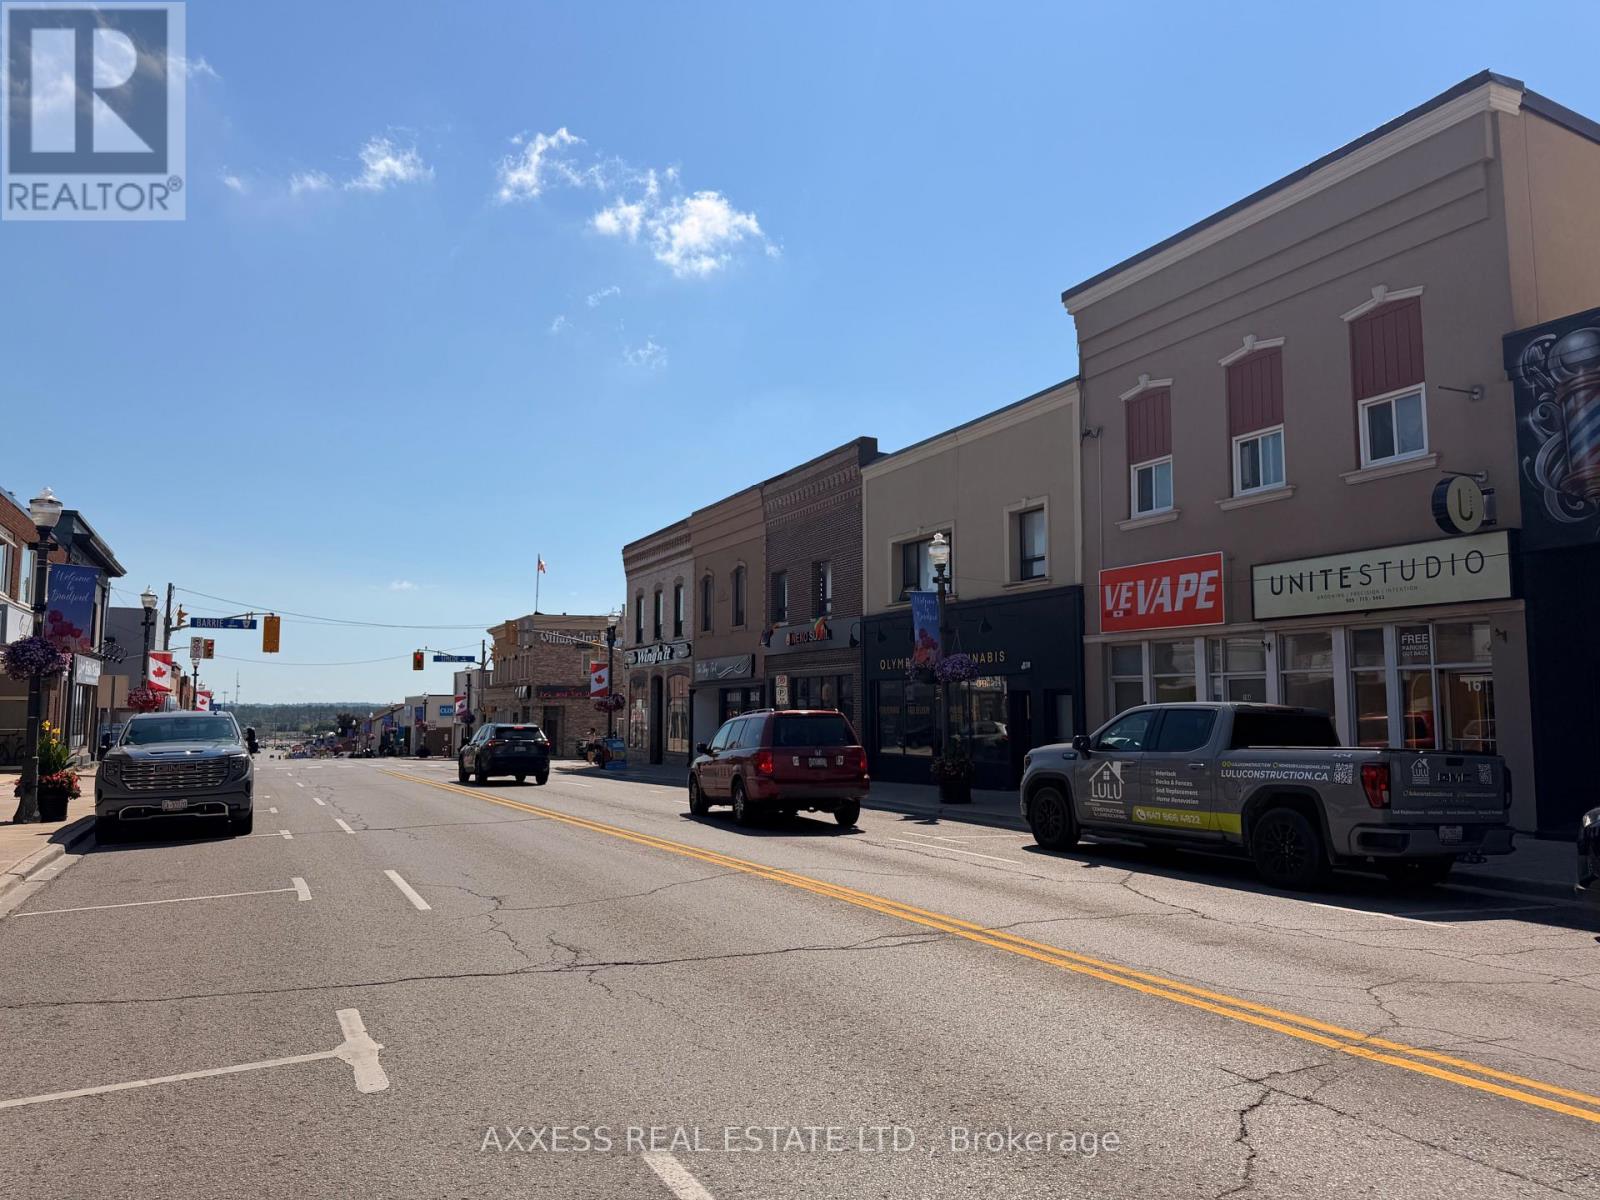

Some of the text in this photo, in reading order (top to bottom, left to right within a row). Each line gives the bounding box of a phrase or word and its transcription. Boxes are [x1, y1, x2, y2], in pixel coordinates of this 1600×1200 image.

[55, 569, 90, 584] Welcome
[49, 588, 90, 605] Bradford
[196, 618, 225, 628] BARRIE
[1401, 633, 1429, 644] FREE
[880, 658, 911, 671] OLYMP
[1221, 769, 1329, 781] LULUCONSTRUCTION.CA
[1092, 780, 1122, 799] LULU
